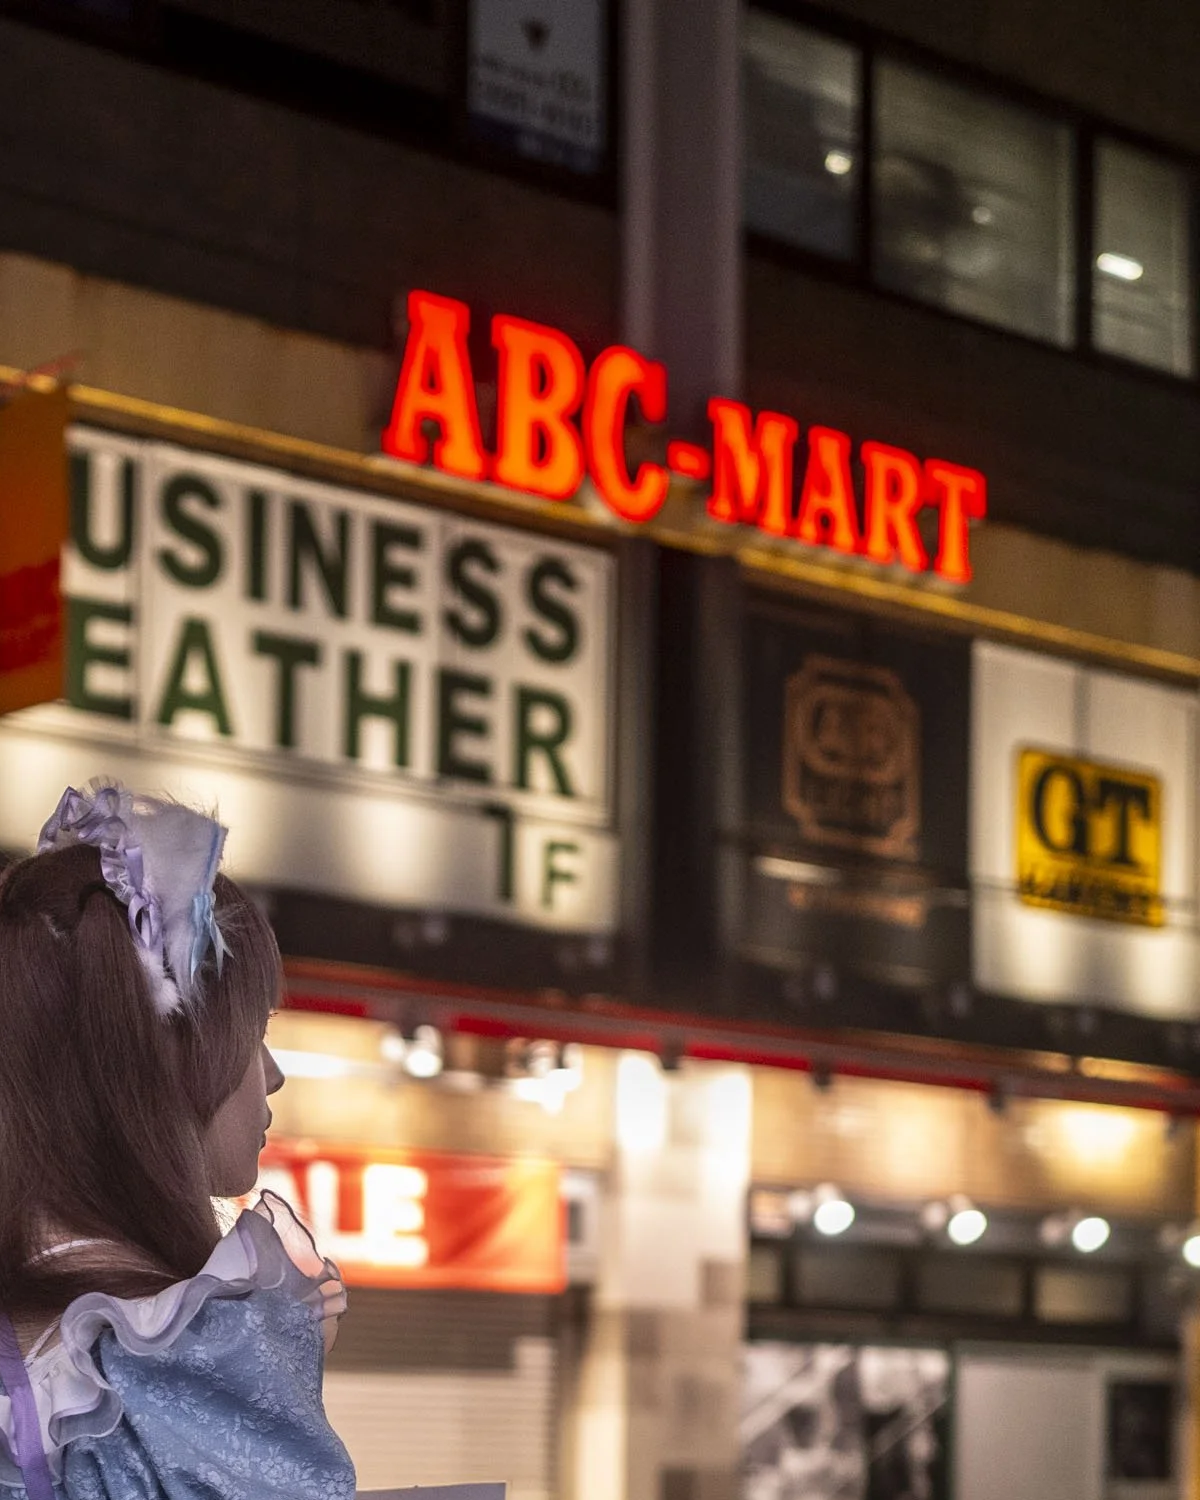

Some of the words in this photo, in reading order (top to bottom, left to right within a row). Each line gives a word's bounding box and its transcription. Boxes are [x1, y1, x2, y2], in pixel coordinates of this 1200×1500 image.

[382, 289, 987, 584] ABC-MART
[68, 444, 582, 667] USINESS
[66, 598, 576, 799] EATHER
[486, 804, 582, 907] 1F
[1030, 765, 1151, 870] GT
[247, 1160, 428, 1268] LE
